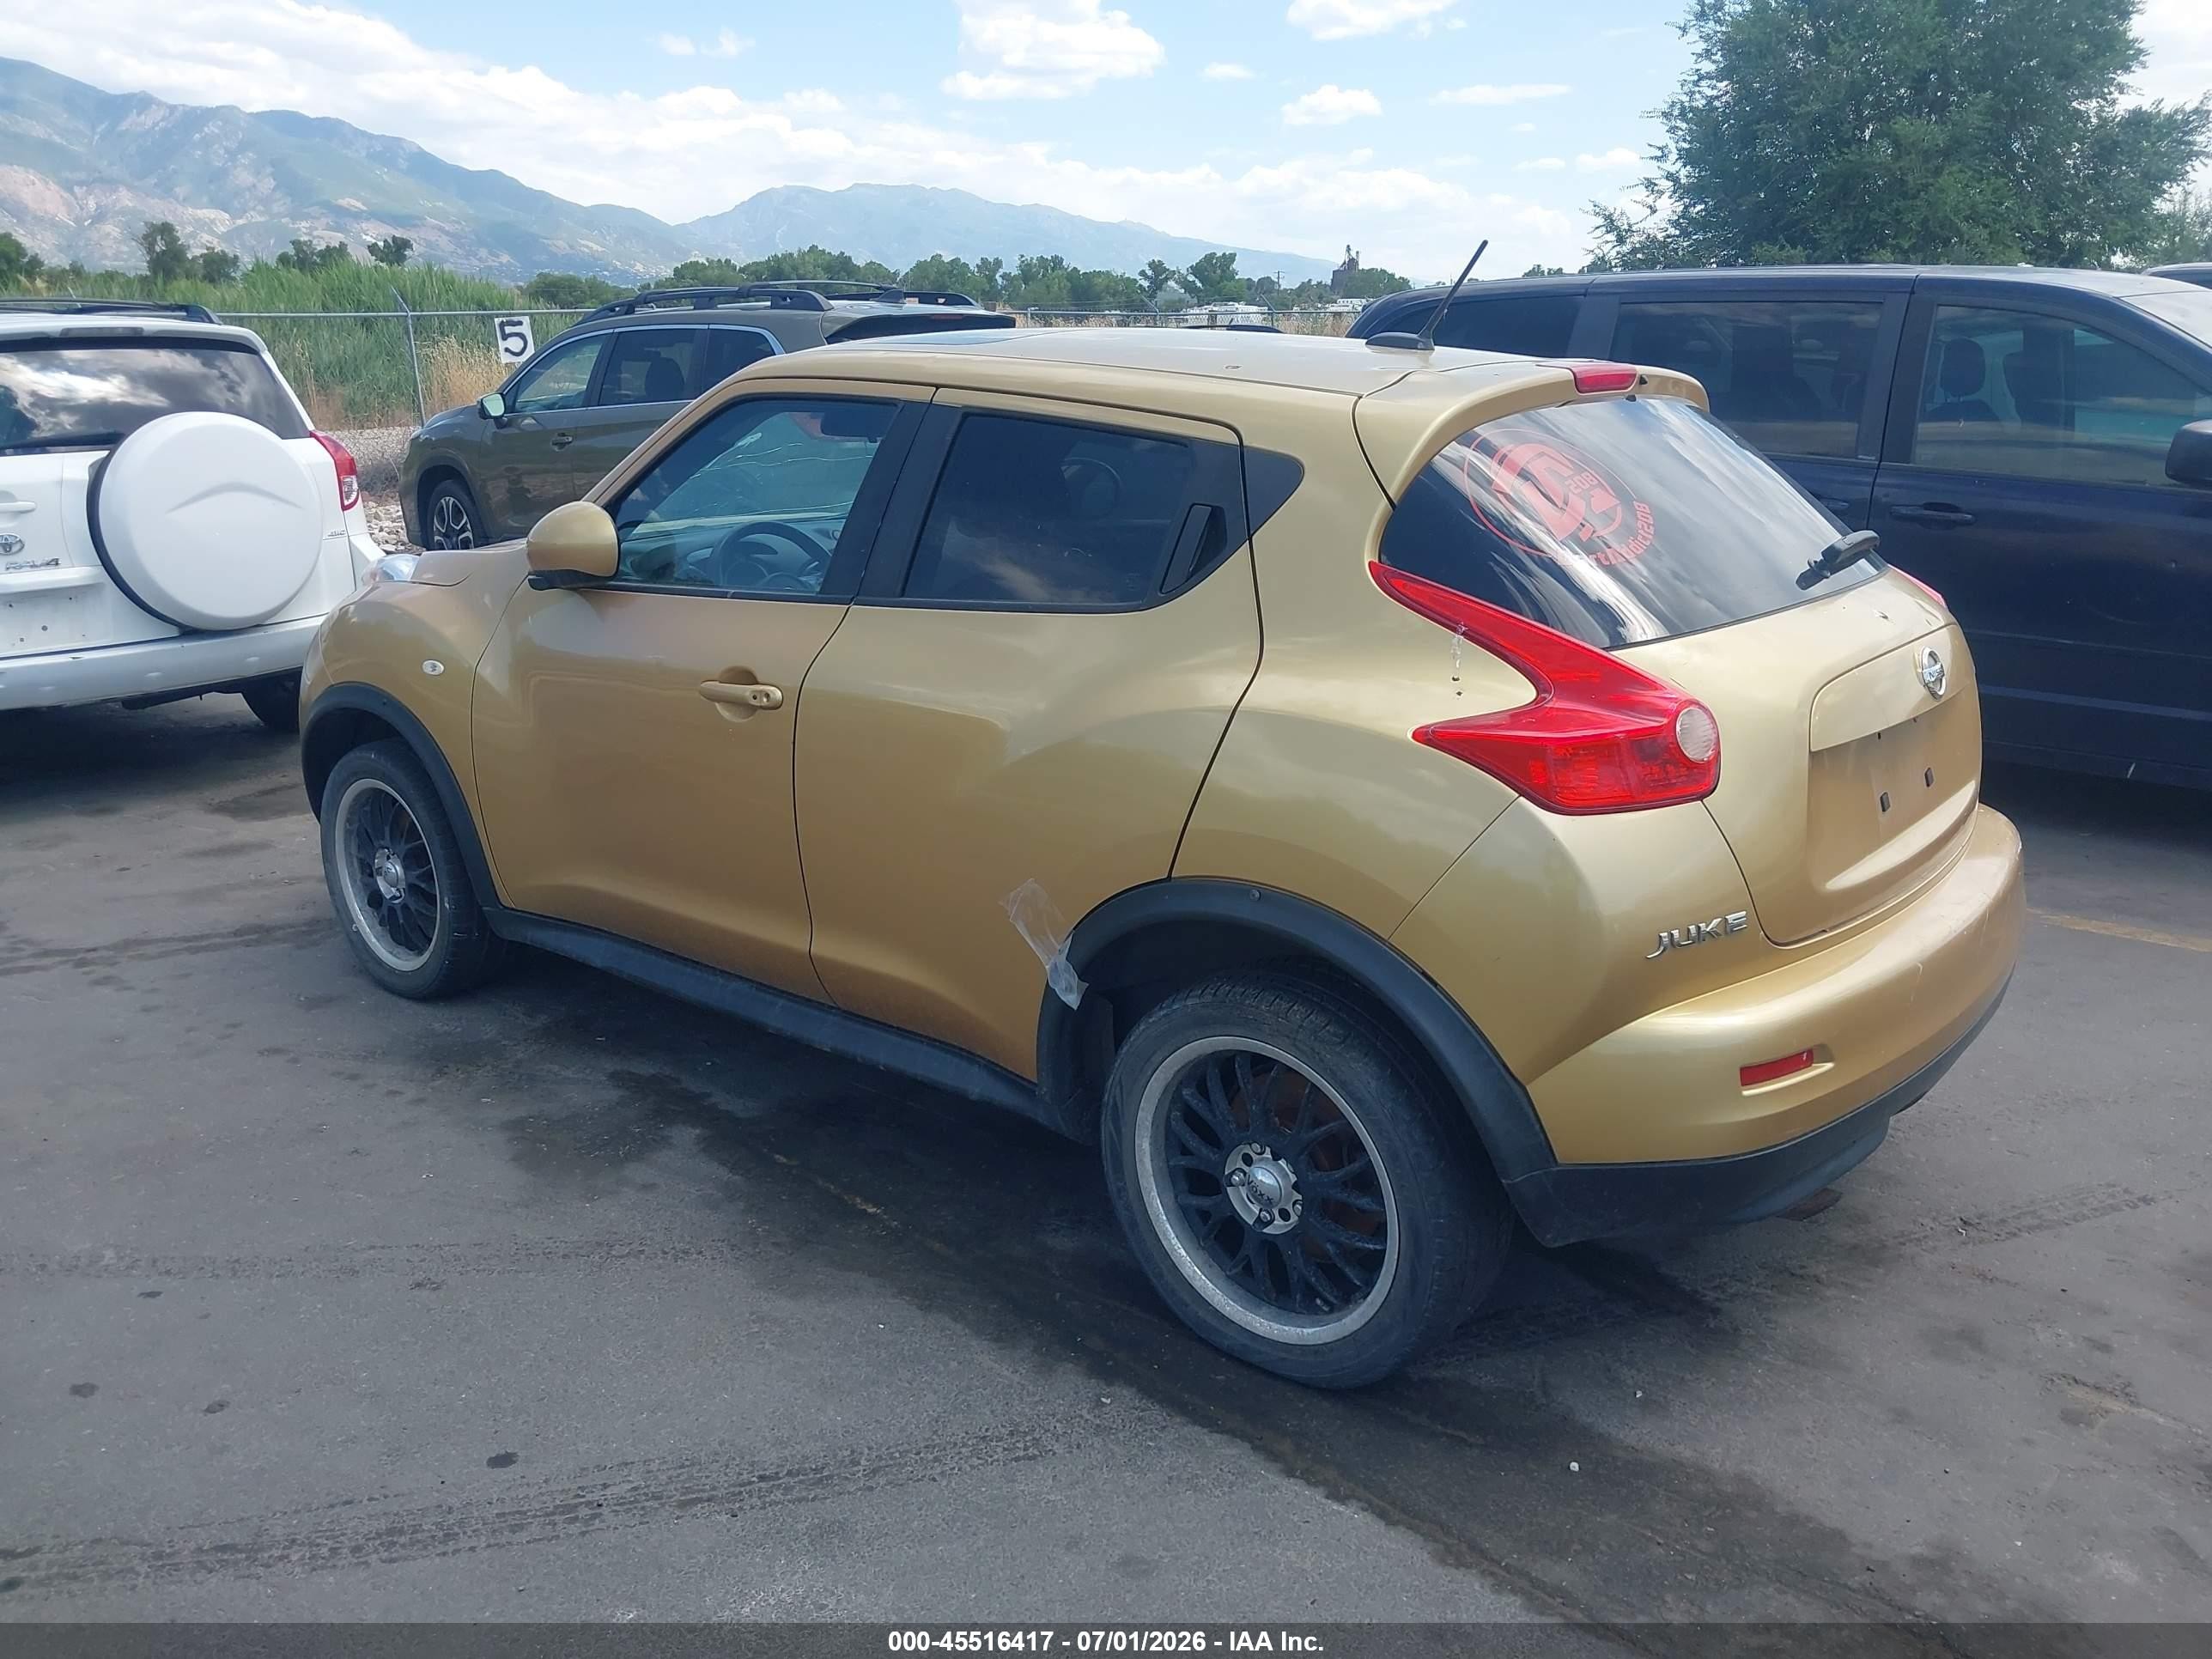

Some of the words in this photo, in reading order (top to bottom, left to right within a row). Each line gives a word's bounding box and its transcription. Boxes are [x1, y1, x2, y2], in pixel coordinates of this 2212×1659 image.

[498, 319, 528, 357] 5
[1565, 471, 1598, 495] 208
[1645, 910, 1747, 959] JUKE
